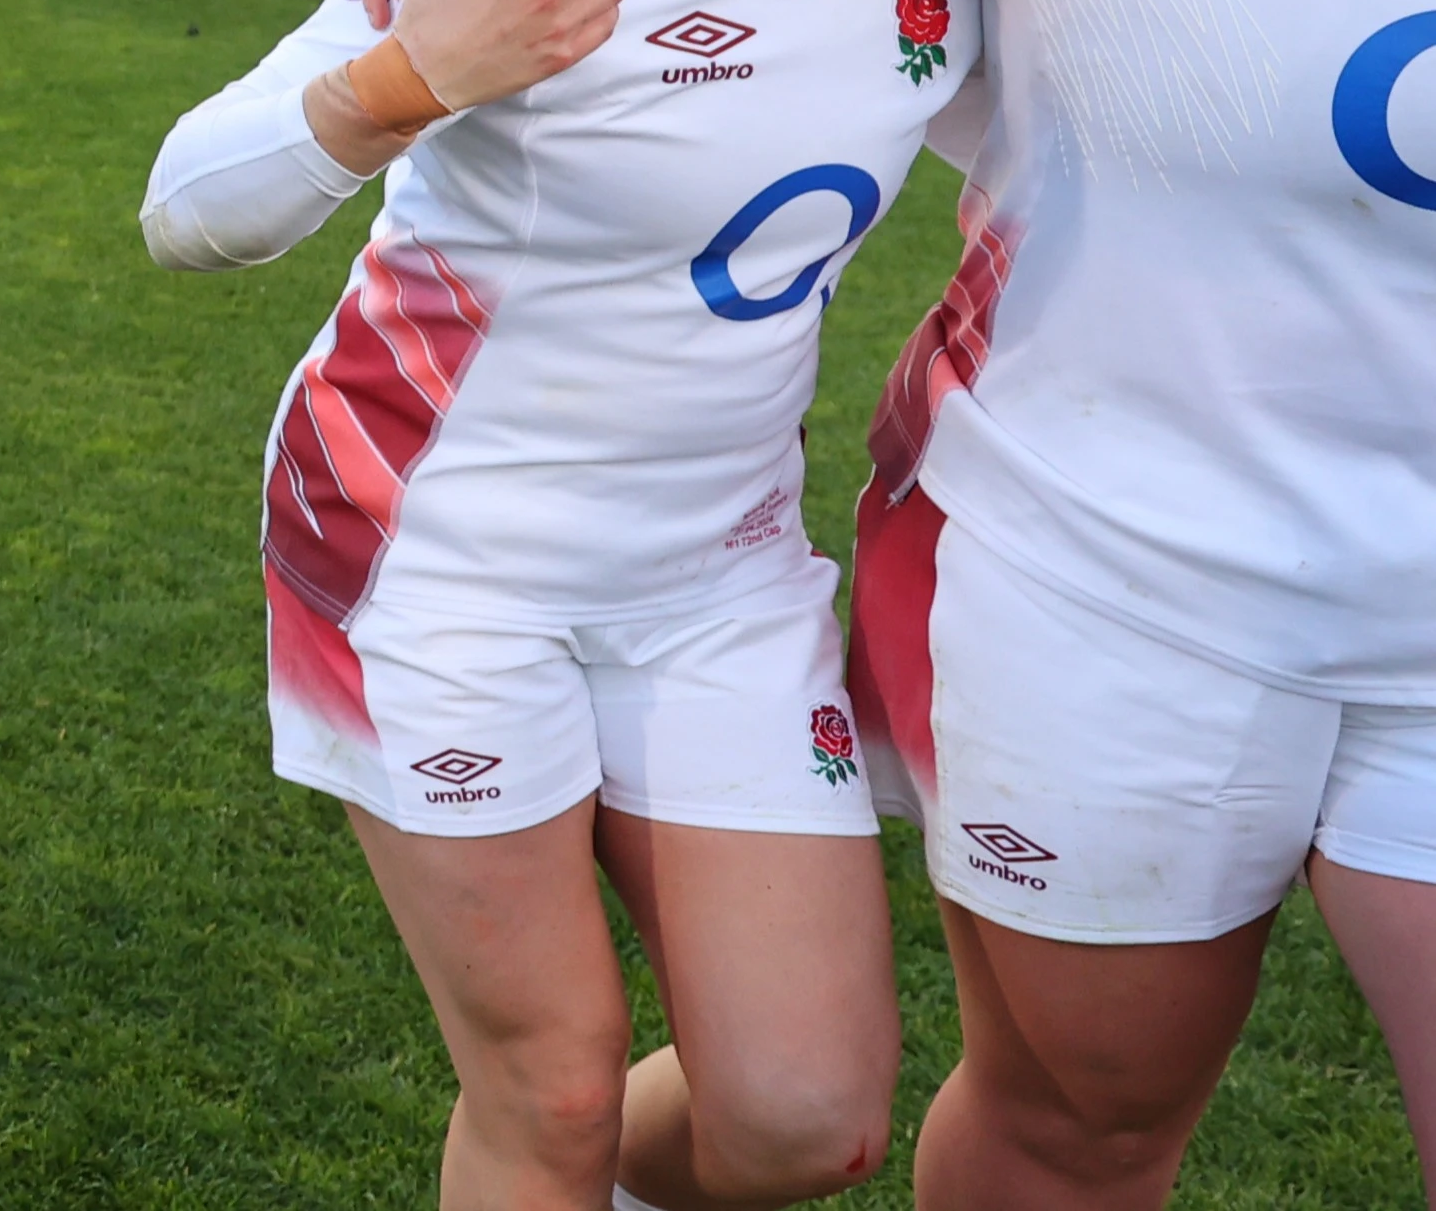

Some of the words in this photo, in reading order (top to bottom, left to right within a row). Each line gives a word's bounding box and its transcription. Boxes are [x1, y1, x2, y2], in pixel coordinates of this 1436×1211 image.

[661, 61, 754, 85] umbro
[764, 525, 781, 538] Cap
[425, 787, 501, 804] umbro
[969, 854, 1047, 891] umbro
